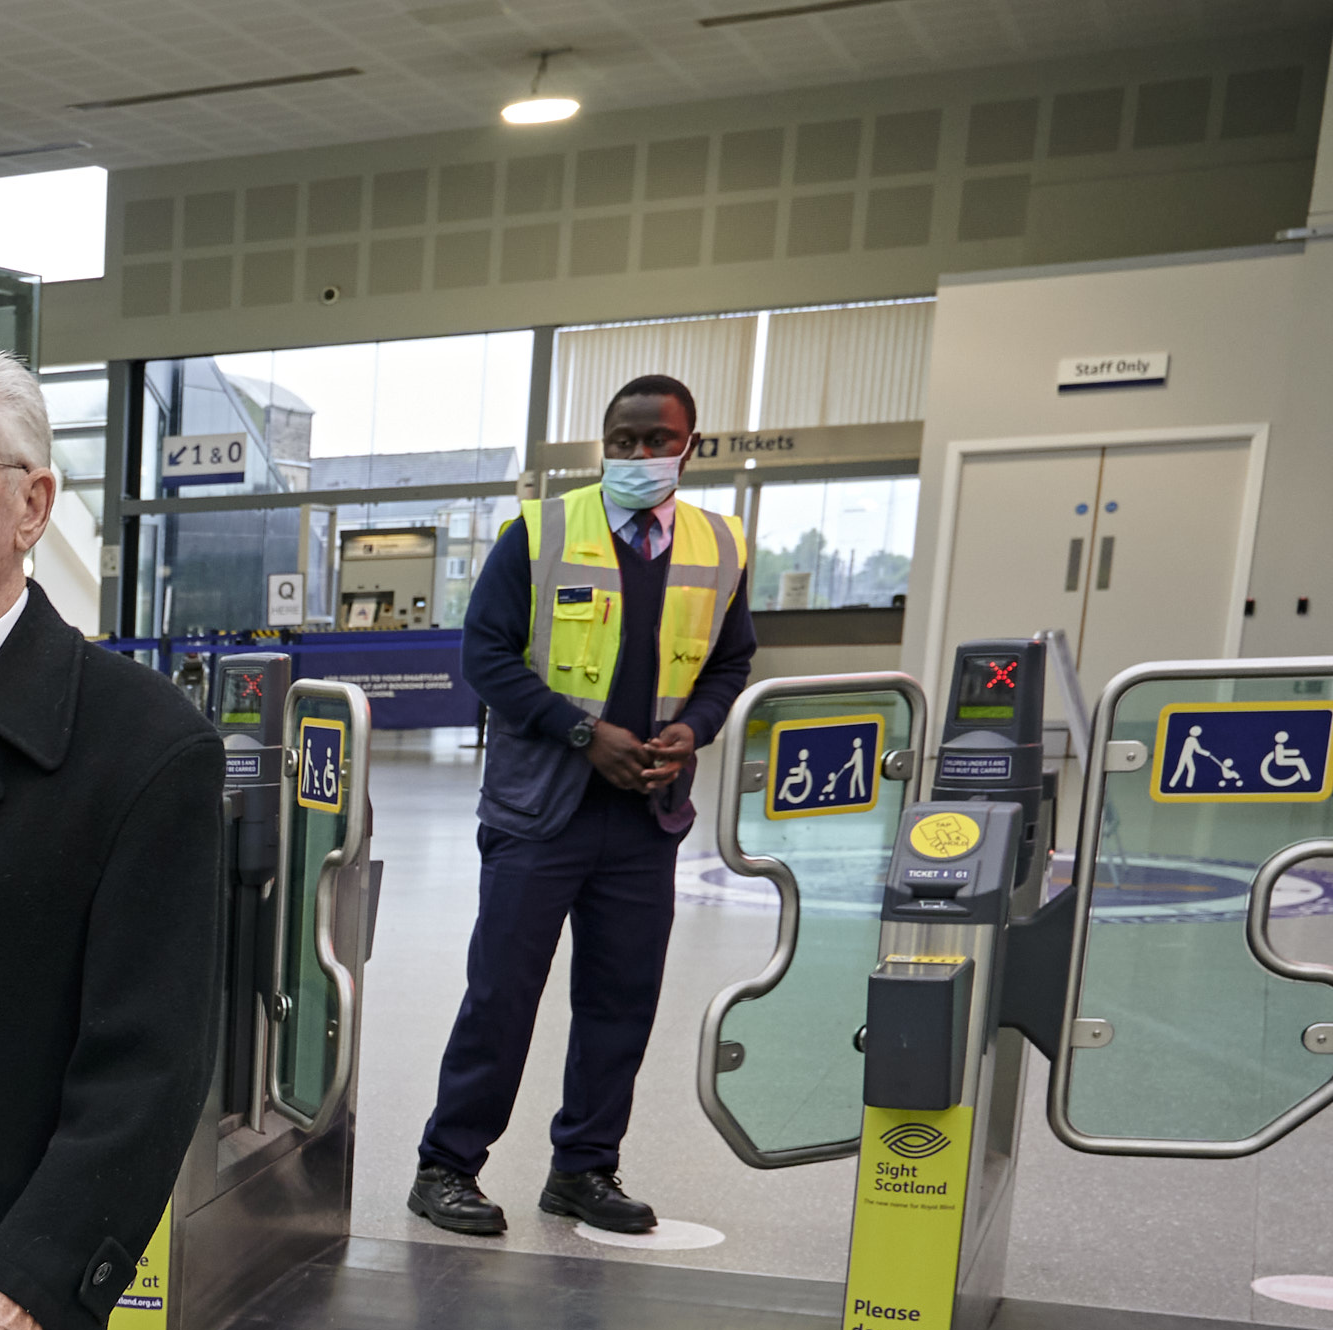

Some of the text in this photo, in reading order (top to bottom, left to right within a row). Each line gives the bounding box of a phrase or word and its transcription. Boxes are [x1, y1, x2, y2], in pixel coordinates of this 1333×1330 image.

[1075, 358, 1150, 376] Staff Only
[729, 435, 794, 453] Tickets
[192, 444, 202, 465] 1
[210, 447, 223, 464] &
[278, 581, 295, 600] Q
[909, 870, 938, 878] TICKET
[876, 1162, 918, 1179] Sight
[874, 1178, 947, 1195] Scotland
[142, 1275, 160, 1288] at
[854, 1299, 921, 1321] Please
